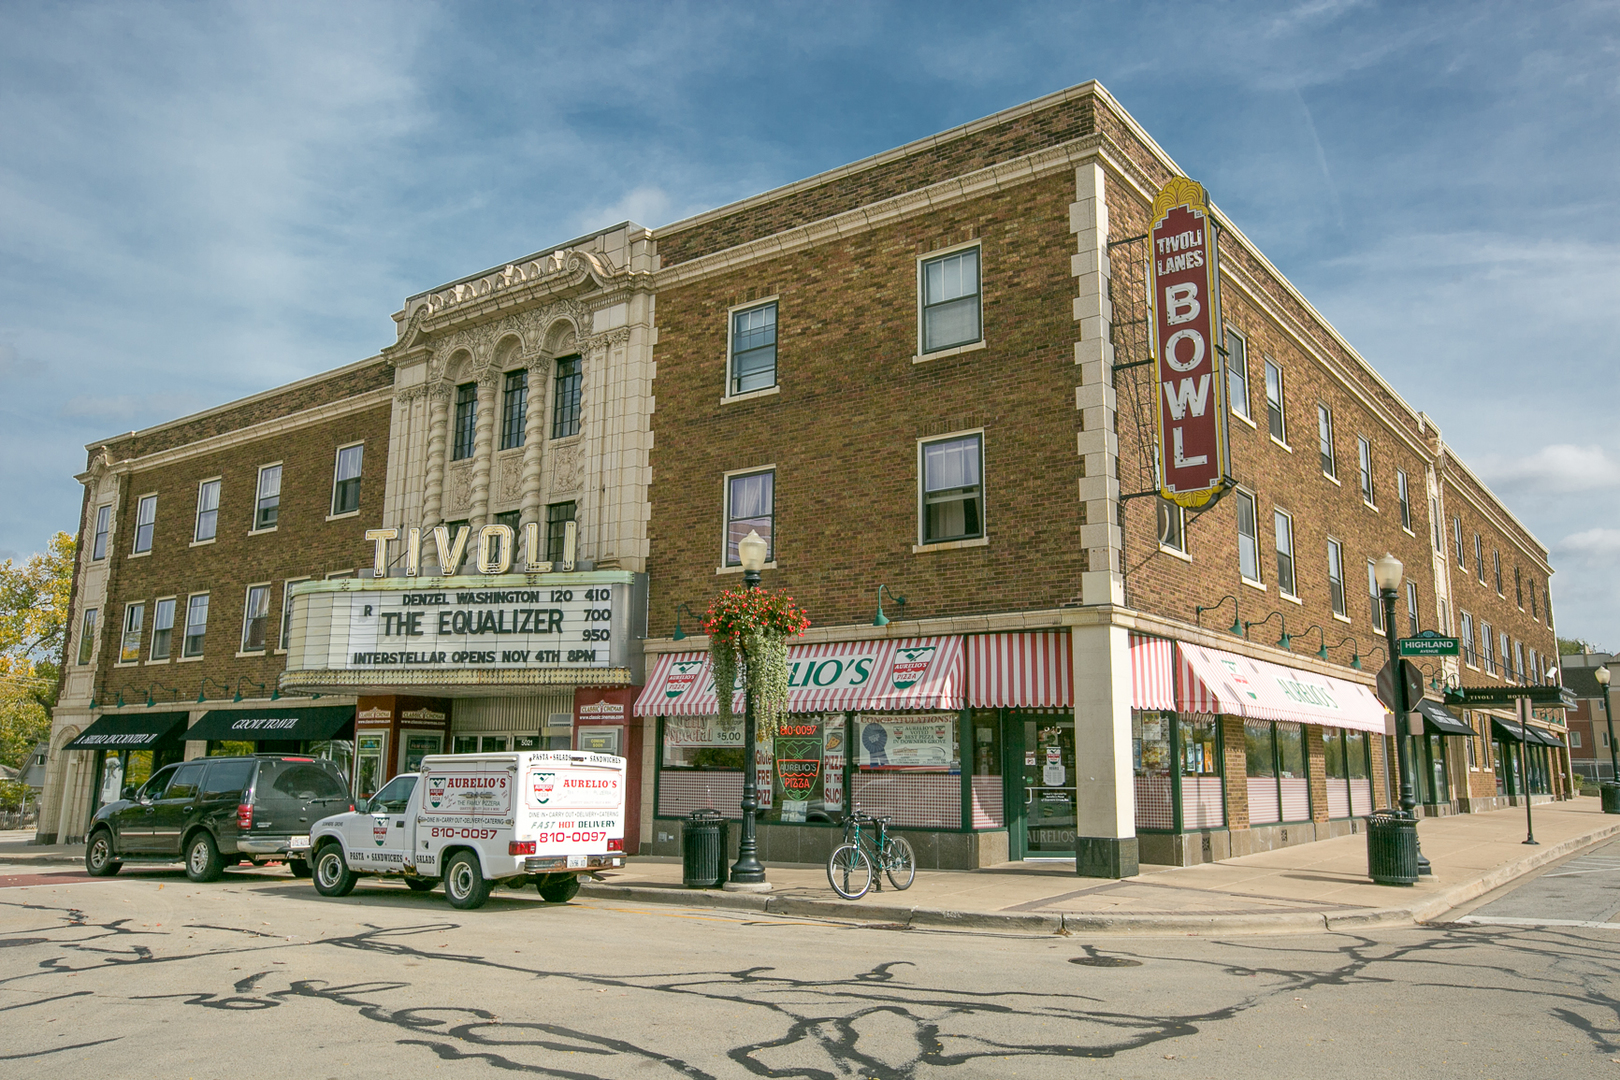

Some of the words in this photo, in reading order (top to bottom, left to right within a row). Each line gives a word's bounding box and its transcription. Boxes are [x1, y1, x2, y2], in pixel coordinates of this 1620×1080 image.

[1156, 229, 1203, 255] TIVOLI
[1157, 250, 1204, 276] LANES
[1162, 281, 1212, 469] BOWL
[365, 521, 577, 577] TIVOLI
[403, 593, 450, 606] DENZEL
[456, 591, 540, 605] WASHINGTON
[550, 590, 573, 602] 120
[584, 589, 611, 601] 410
[364, 605, 373, 616] R
[583, 609, 611, 621] 700
[381, 611, 425, 636] THE
[438, 608, 565, 636] EQUALIZER
[582, 629, 611, 641] 950
[1405, 641, 1454, 649] HIGHLAND
[353, 651, 447, 664] INTERSTELLAR
[451, 651, 496, 663] OPENS
[501, 650, 530, 662] NOV
[534, 650, 560, 662] 4TH
[567, 649, 596, 662] 8PM
[780, 763, 817, 772] AURELIO'S
[447, 778, 507, 788] AURELIO'S
[563, 779, 618, 789] AURELIO'S
[784, 777, 810, 788] PIZZA
[531, 821, 556, 829] FAST
[558, 821, 575, 829] HOT
[578, 820, 616, 829] DELIVERY
[431, 827, 498, 840] 810-0097
[539, 831, 606, 843] 810-0097
[350, 852, 364, 861] PASTA
[371, 853, 403, 863] SANDWICHES
[416, 854, 435, 864] SALADS
